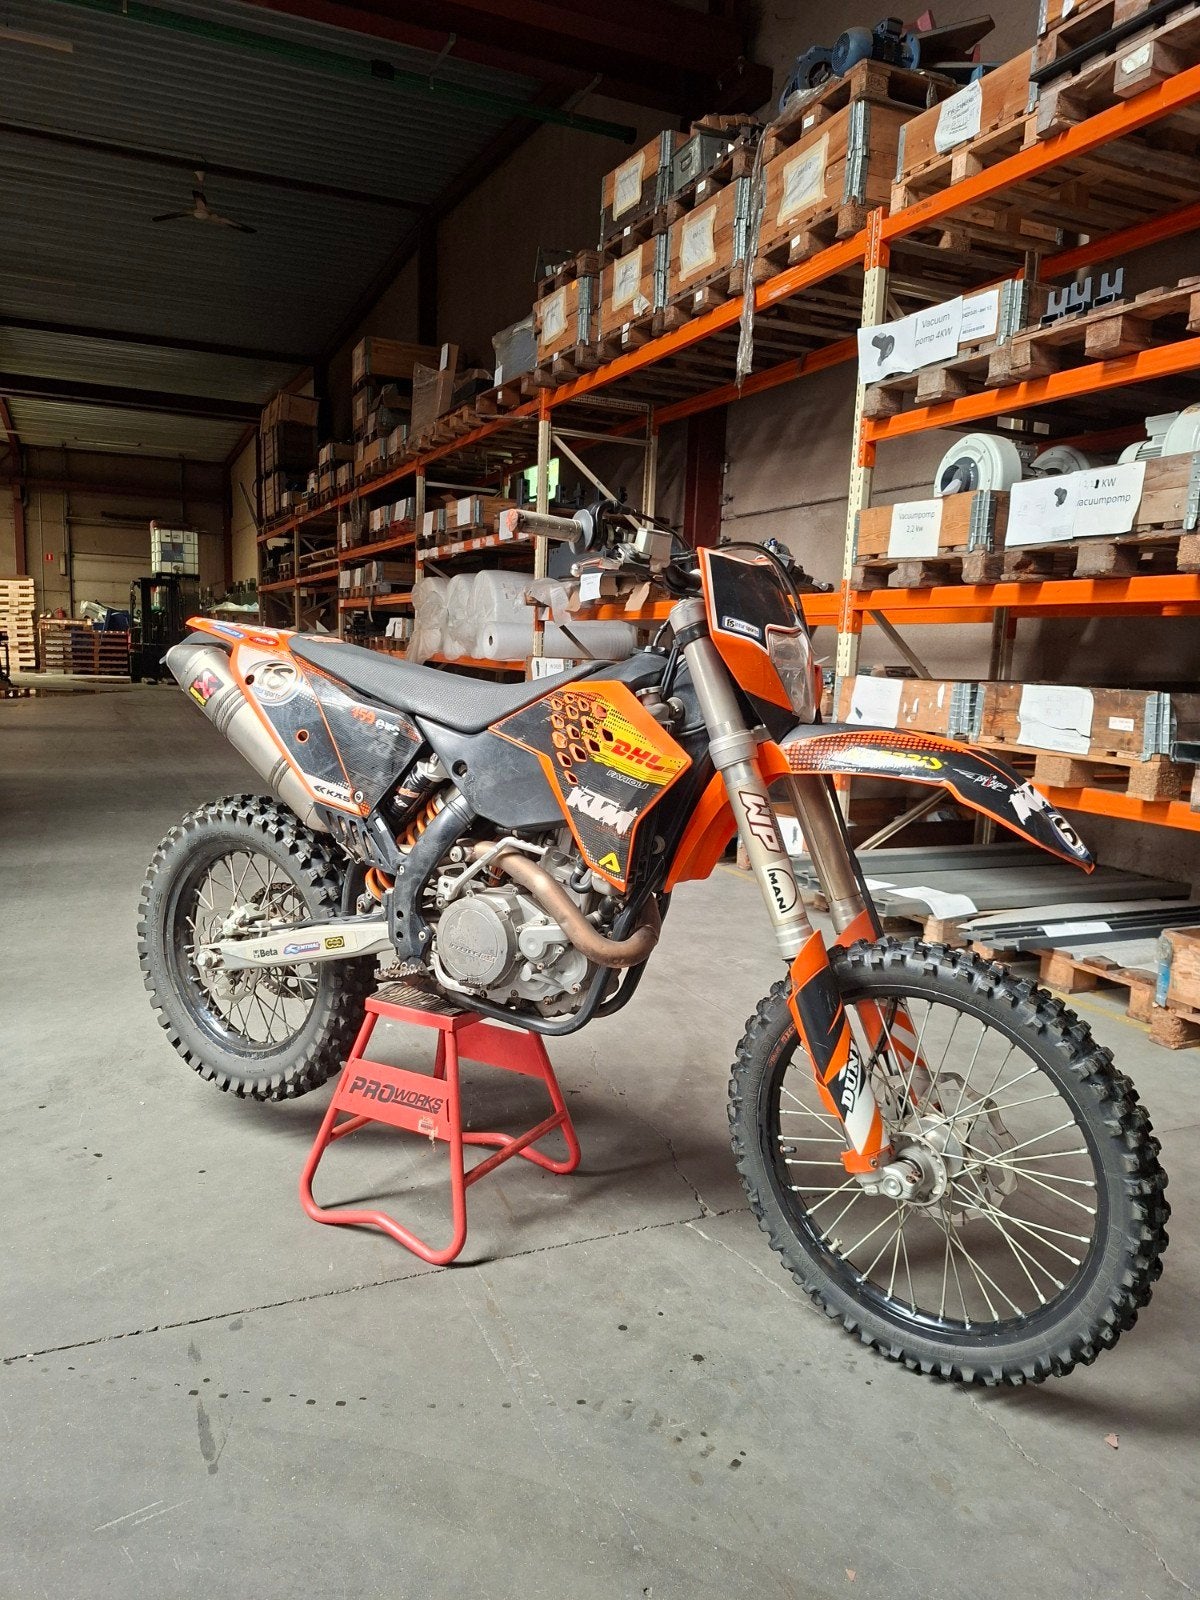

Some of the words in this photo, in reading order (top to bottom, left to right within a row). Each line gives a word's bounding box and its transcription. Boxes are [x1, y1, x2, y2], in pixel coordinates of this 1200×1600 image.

[921, 313, 951, 329] Vacuum
[915, 334, 935, 348] pomp
[936, 326, 953, 340] 4KW
[1101, 477, 1117, 488] KW
[611, 738, 666, 772] DHL
[565, 785, 638, 835] KTM
[738, 791, 782, 854] WP
[768, 871, 787, 911] MAN
[260, 948, 279, 958] Beta
